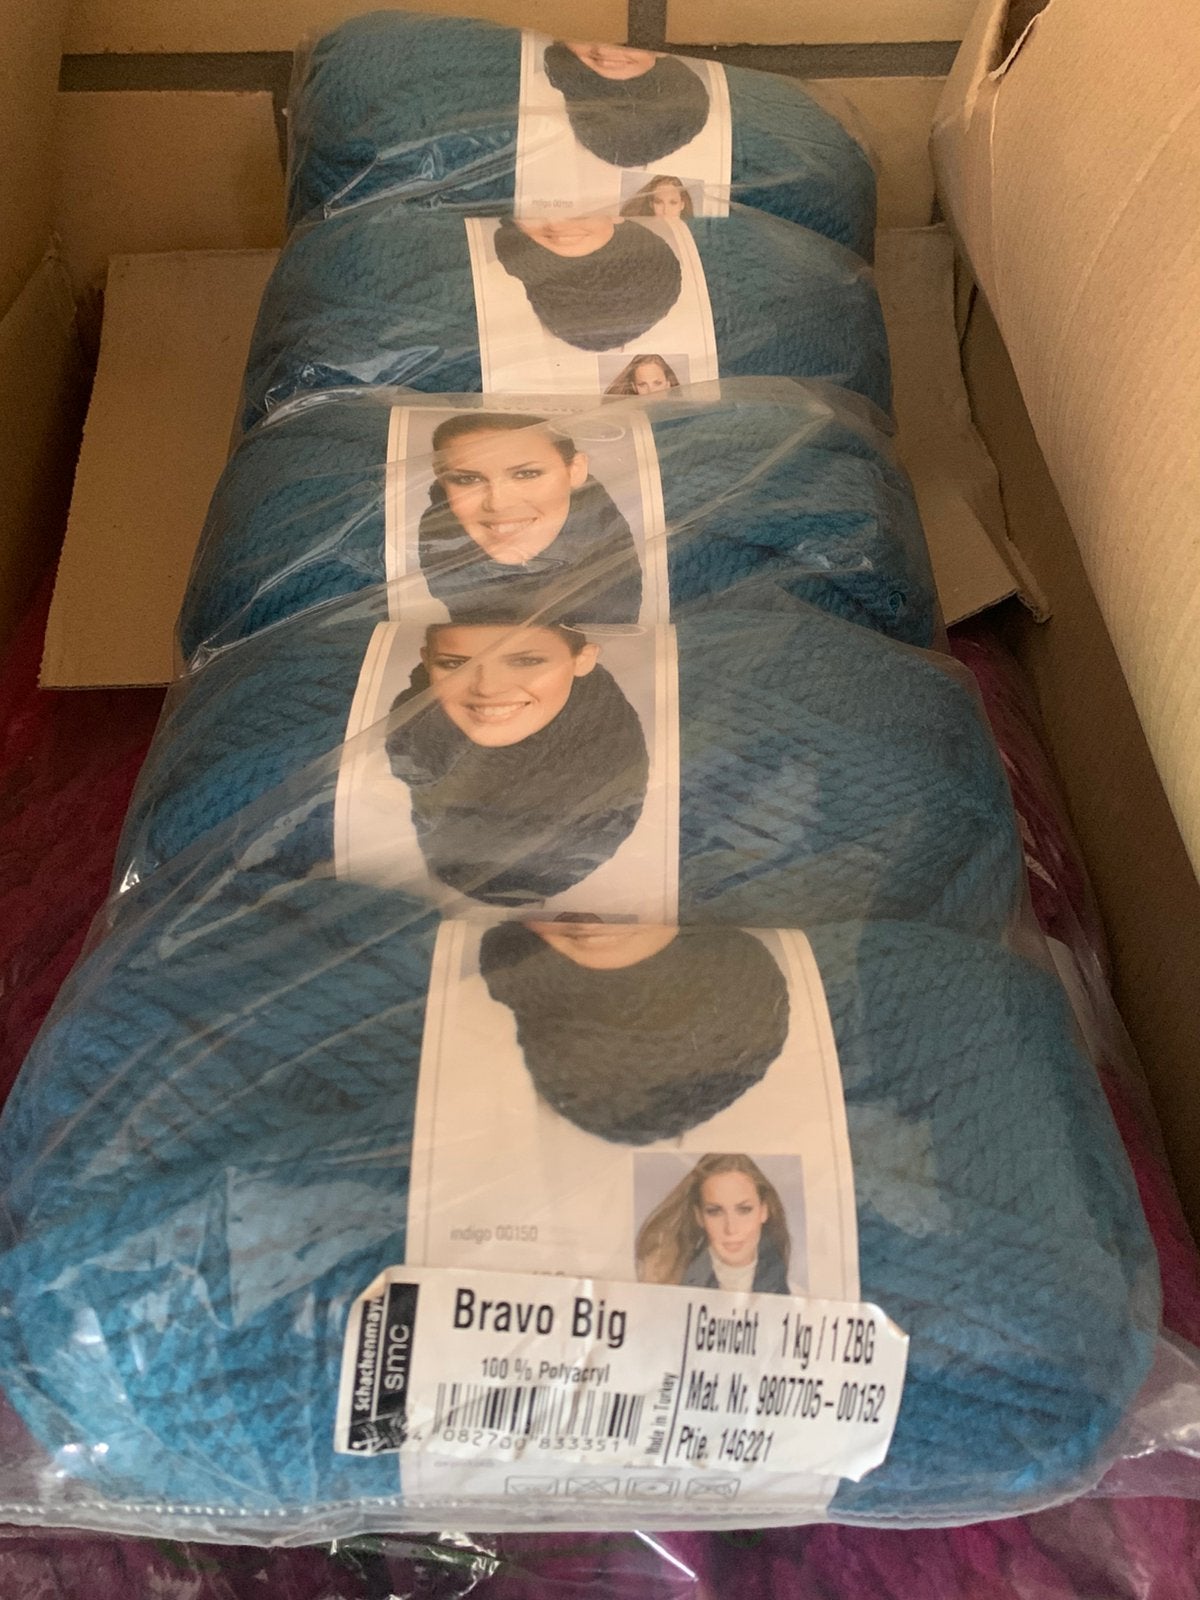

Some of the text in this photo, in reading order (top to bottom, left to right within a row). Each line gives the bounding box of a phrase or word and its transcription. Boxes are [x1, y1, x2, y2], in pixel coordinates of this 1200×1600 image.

[450, 1224, 538, 1244] indigo 00150
[453, 1287, 627, 1348] Bravo Big
[695, 1304, 876, 1370] Gewicht 1 kg / 1 ZBG
[383, 1323, 410, 1390] smc
[481, 1357, 610, 1383] 100 % Polyacryl
[644, 1372, 679, 1455] Made in Turkey
[685, 1371, 720, 1413] Mat.
[726, 1373, 749, 1415] Nr.
[442, 1430, 527, 1451] 082700
[538, 1437, 620, 1454] 833351
[716, 1430, 775, 1463] 146221
